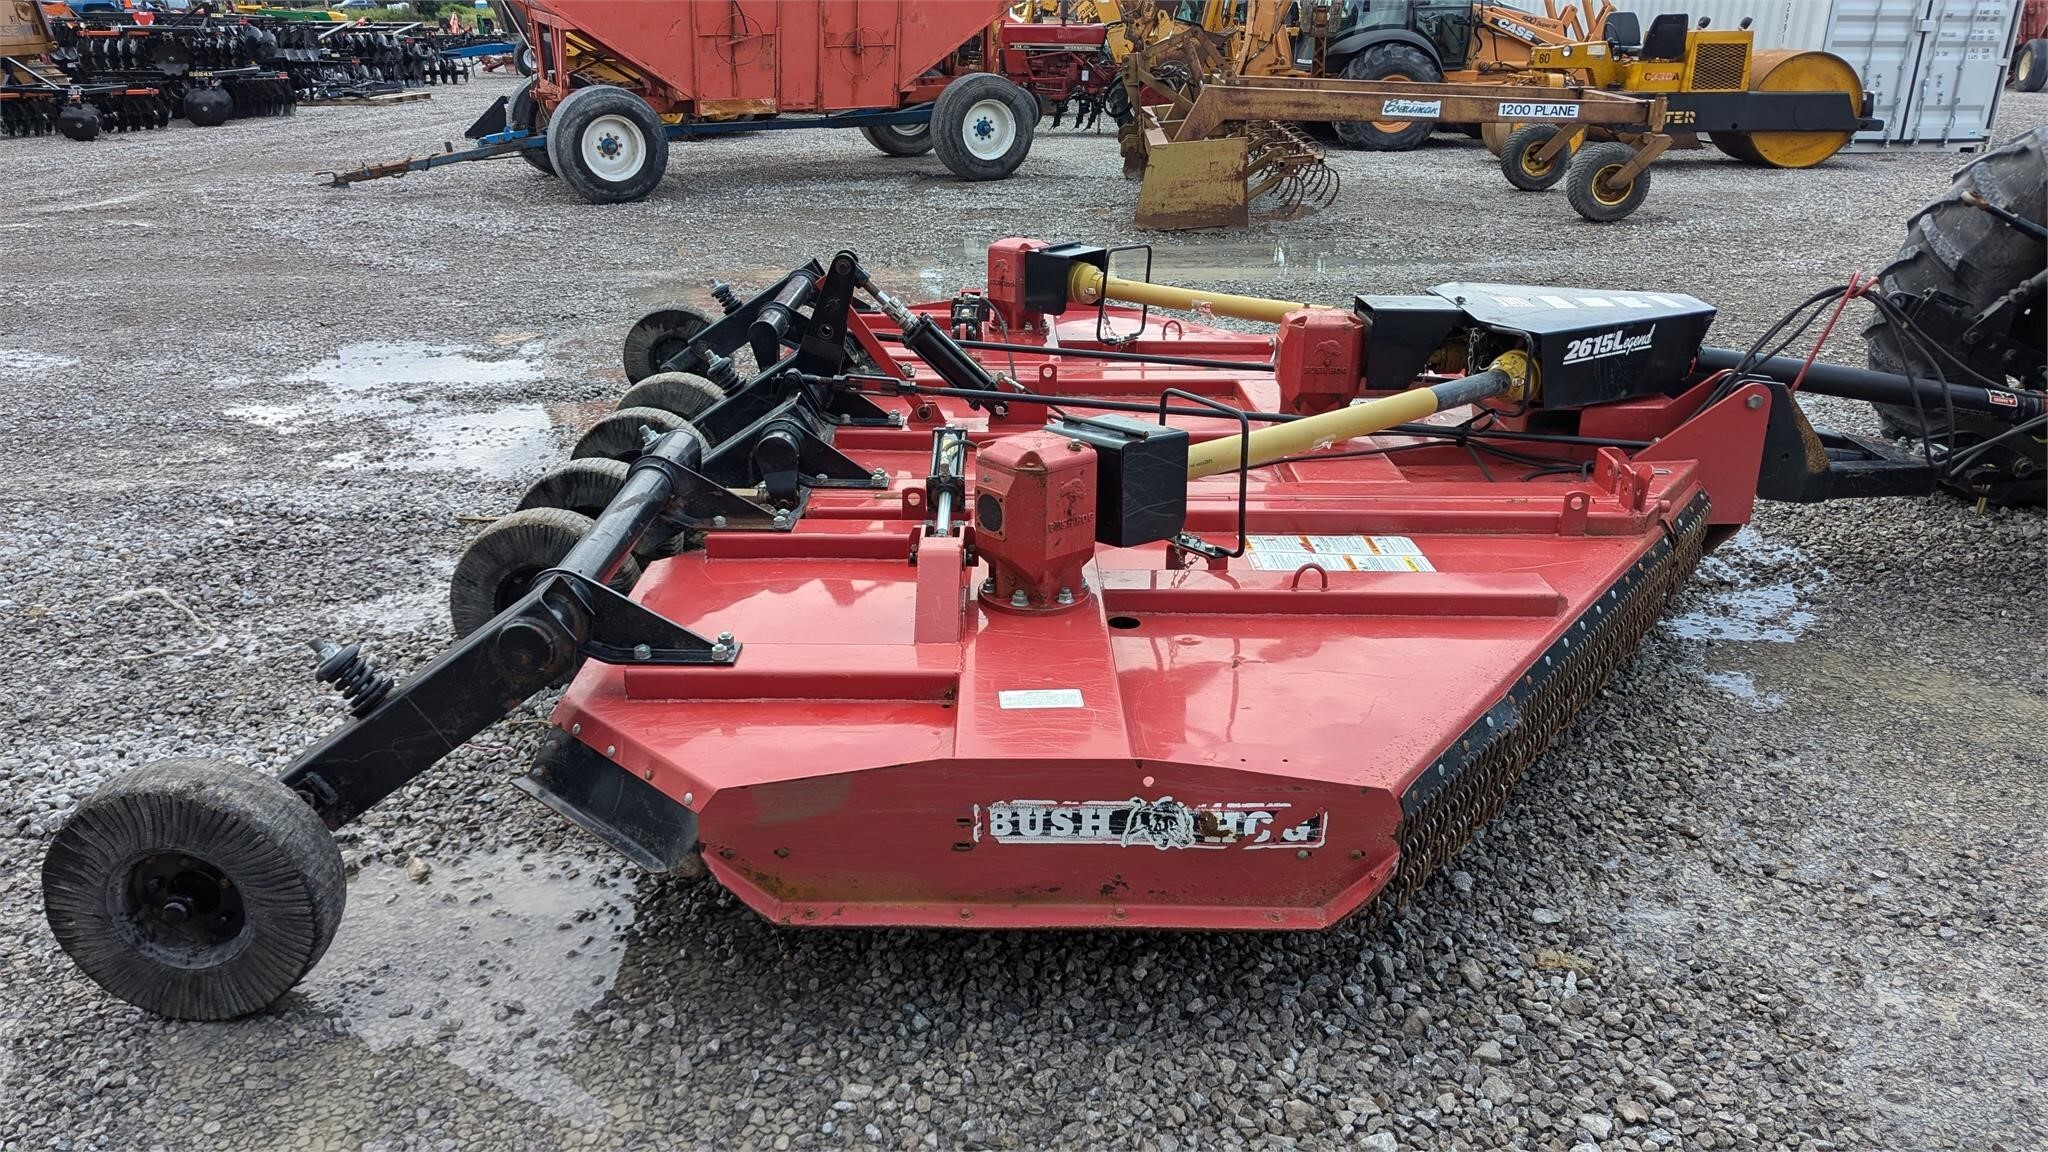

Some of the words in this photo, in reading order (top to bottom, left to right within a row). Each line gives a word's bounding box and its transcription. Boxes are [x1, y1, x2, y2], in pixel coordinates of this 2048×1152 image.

[1497, 19, 1536, 41] CASE
[1538, 53, 1551, 64] 60
[1501, 104, 1531, 116] 1200
[1534, 105, 1576, 117] PLANE
[989, 805, 1113, 836] BUSH
